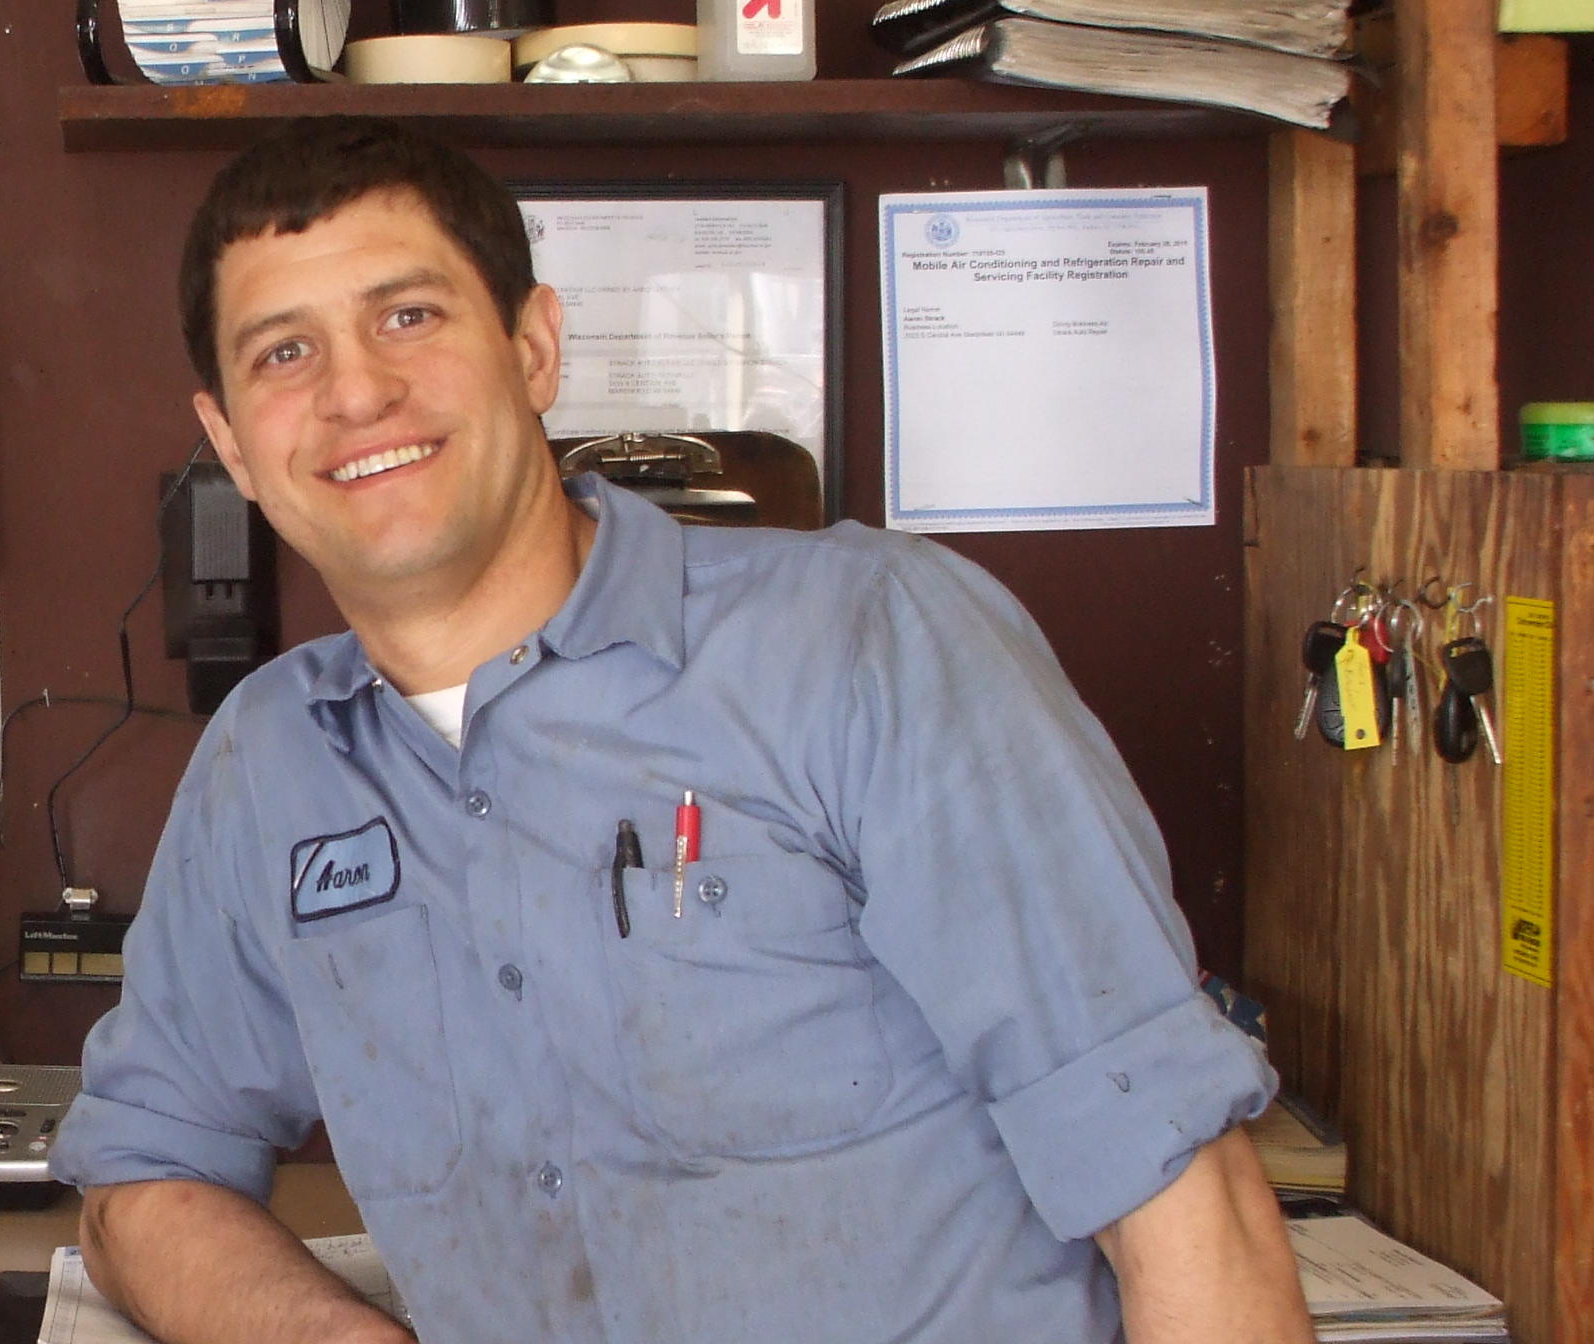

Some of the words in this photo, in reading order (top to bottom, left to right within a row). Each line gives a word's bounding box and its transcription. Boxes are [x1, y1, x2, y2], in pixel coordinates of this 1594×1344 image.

[912, 260, 948, 270] Mobile
[951, 260, 966, 270] Air
[969, 258, 1037, 270] Conditioning
[1040, 257, 1060, 267] and
[1063, 256, 1128, 270] Refrigeration
[1131, 256, 1163, 269] Repair
[1166, 256, 1185, 266] and
[974, 271, 1023, 282] Servicing
[1026, 270, 1064, 282] Facility
[1067, 269, 1128, 281] Registration
[568, 332, 608, 341] Wisconsin
[609, 332, 649, 342] Department
[316, 860, 371, 893] Aaron
